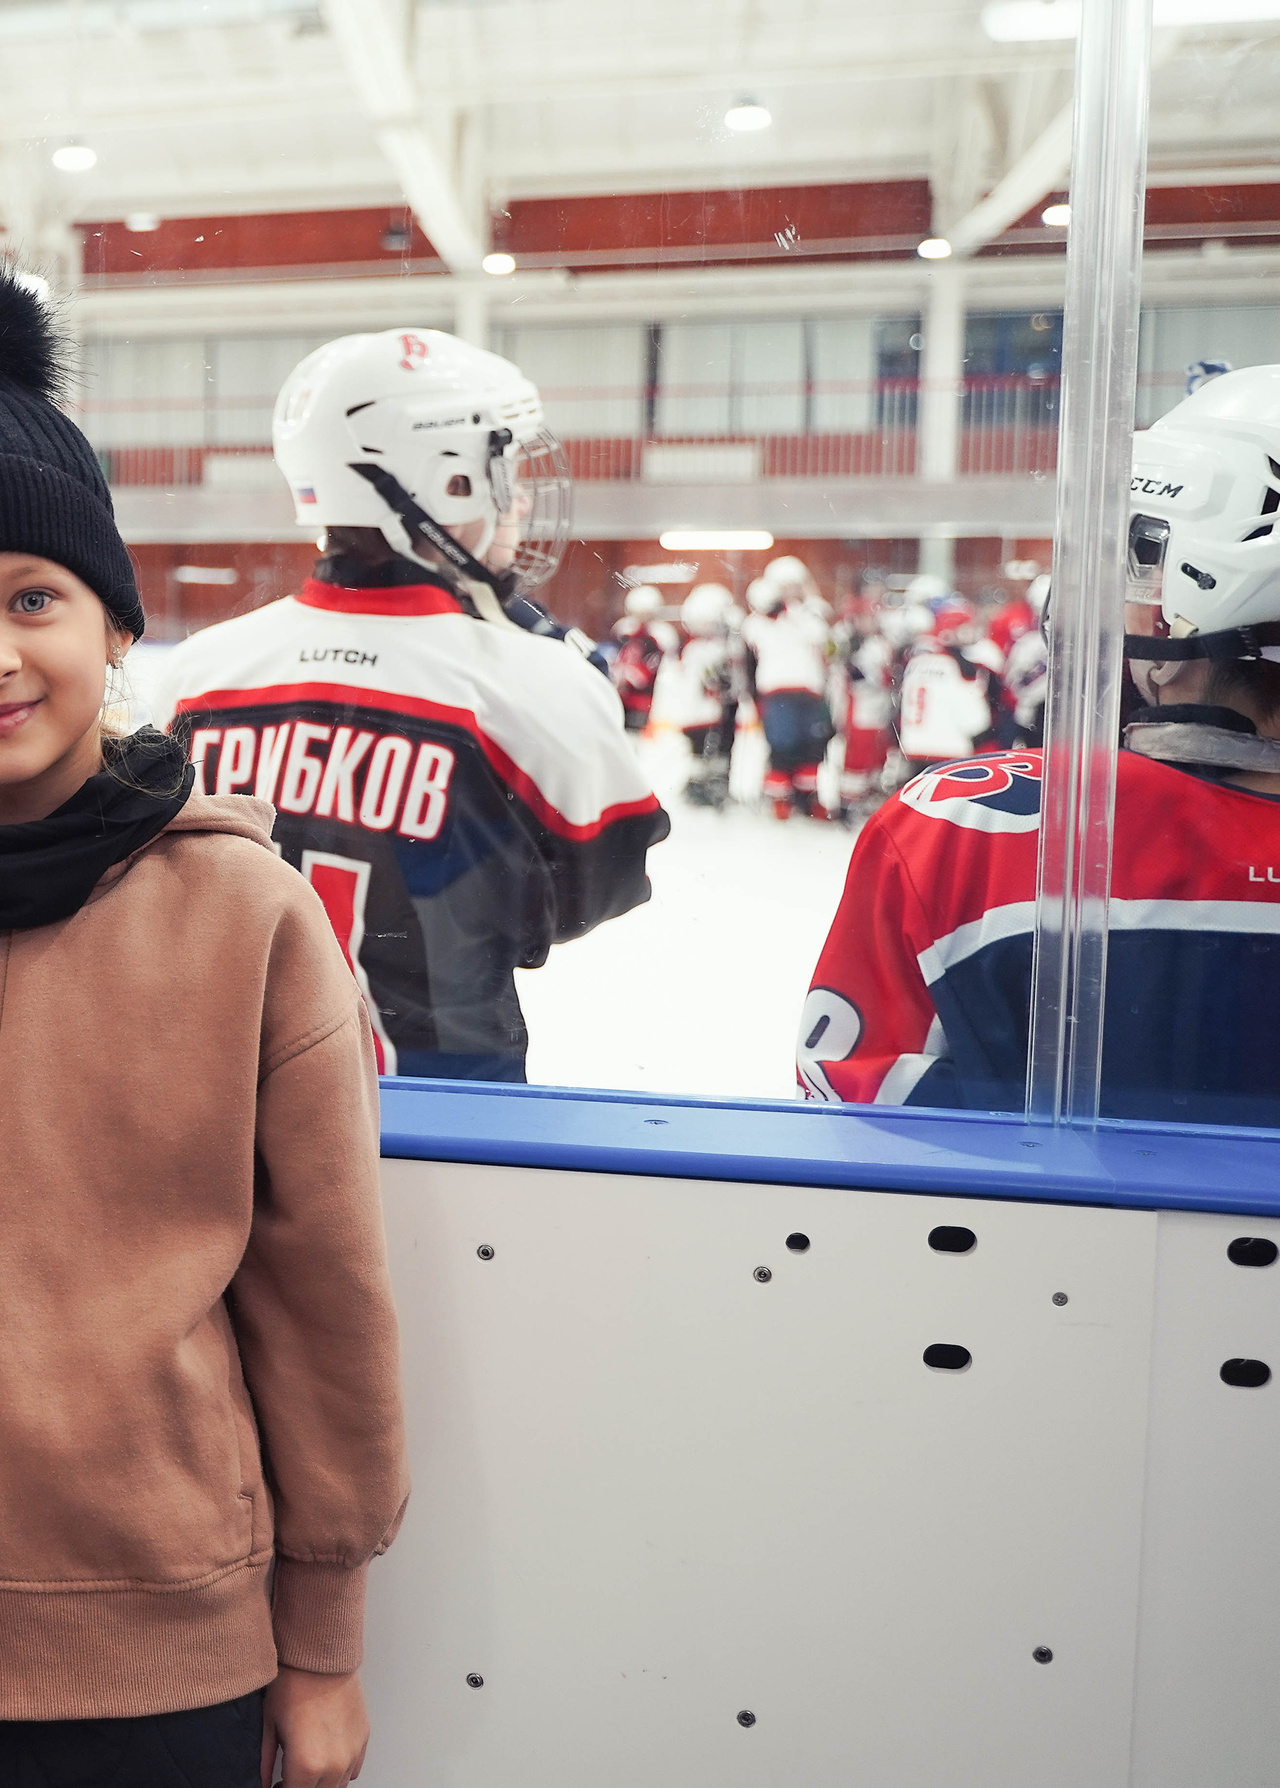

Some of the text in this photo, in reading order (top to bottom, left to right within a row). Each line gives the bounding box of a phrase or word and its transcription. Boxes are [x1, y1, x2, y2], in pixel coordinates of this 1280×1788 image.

[1130, 477, 1184, 498] CCM
[299, 649, 378, 667] LUTCH
[190, 719, 455, 841] ГРИБКОВ
